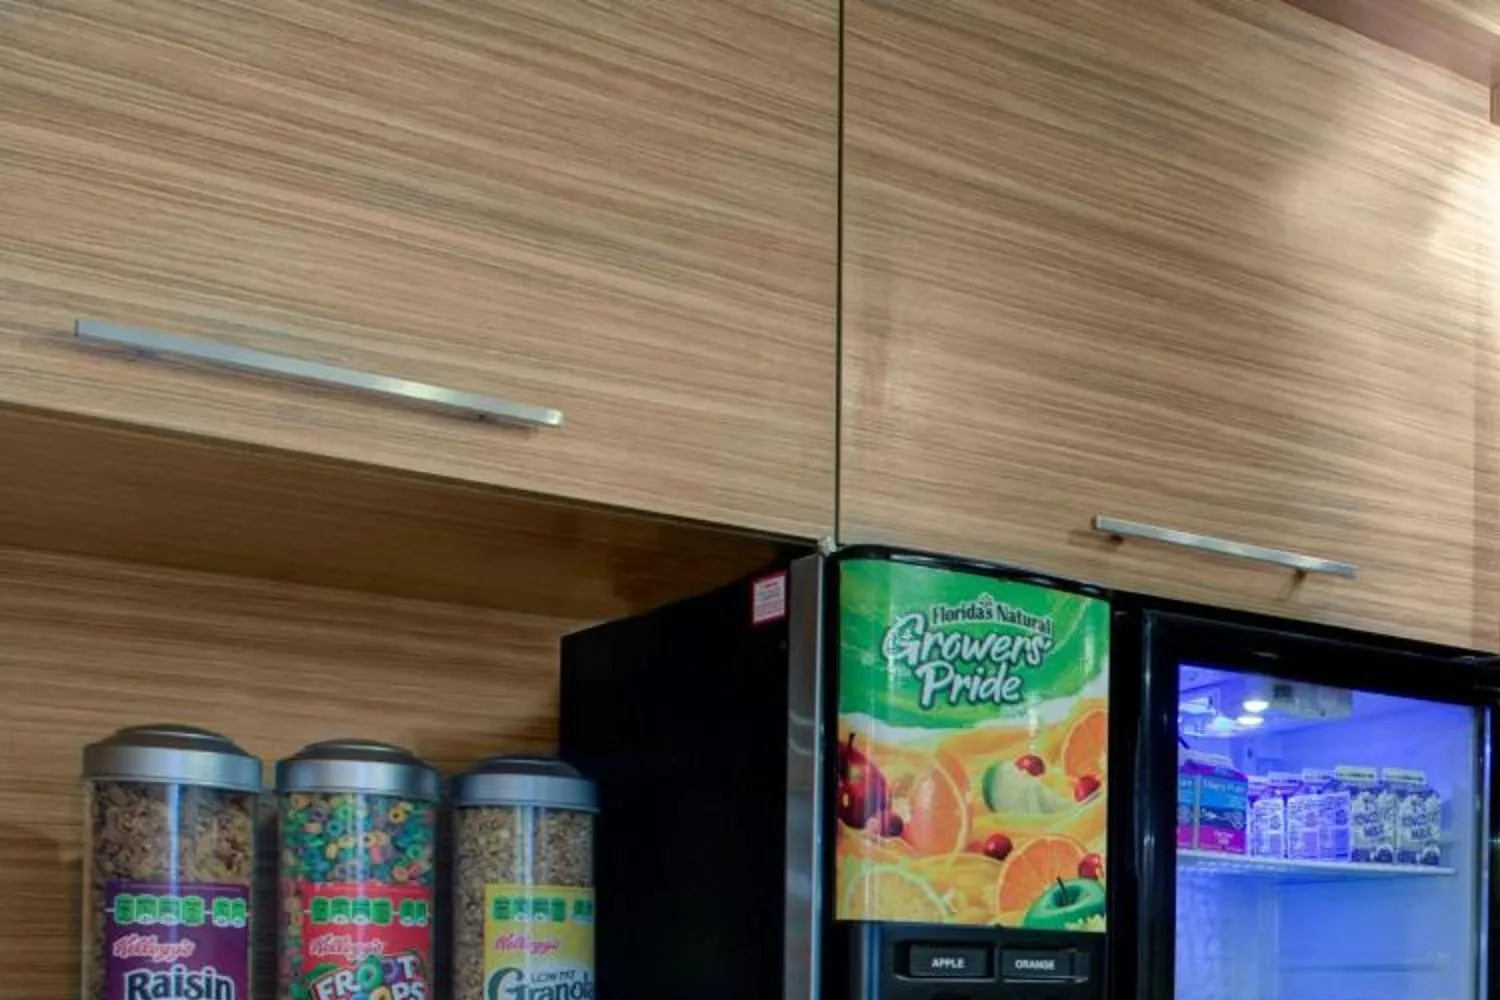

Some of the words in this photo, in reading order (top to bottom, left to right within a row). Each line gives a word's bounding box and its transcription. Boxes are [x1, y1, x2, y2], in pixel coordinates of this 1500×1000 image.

[997, 605, 1053, 634] Natural
[914, 660, 1023, 707] Pride
[112, 933, 197, 963] Kellogg's
[931, 957, 966, 969] APPLE
[1015, 959, 1056, 971] ORANGE
